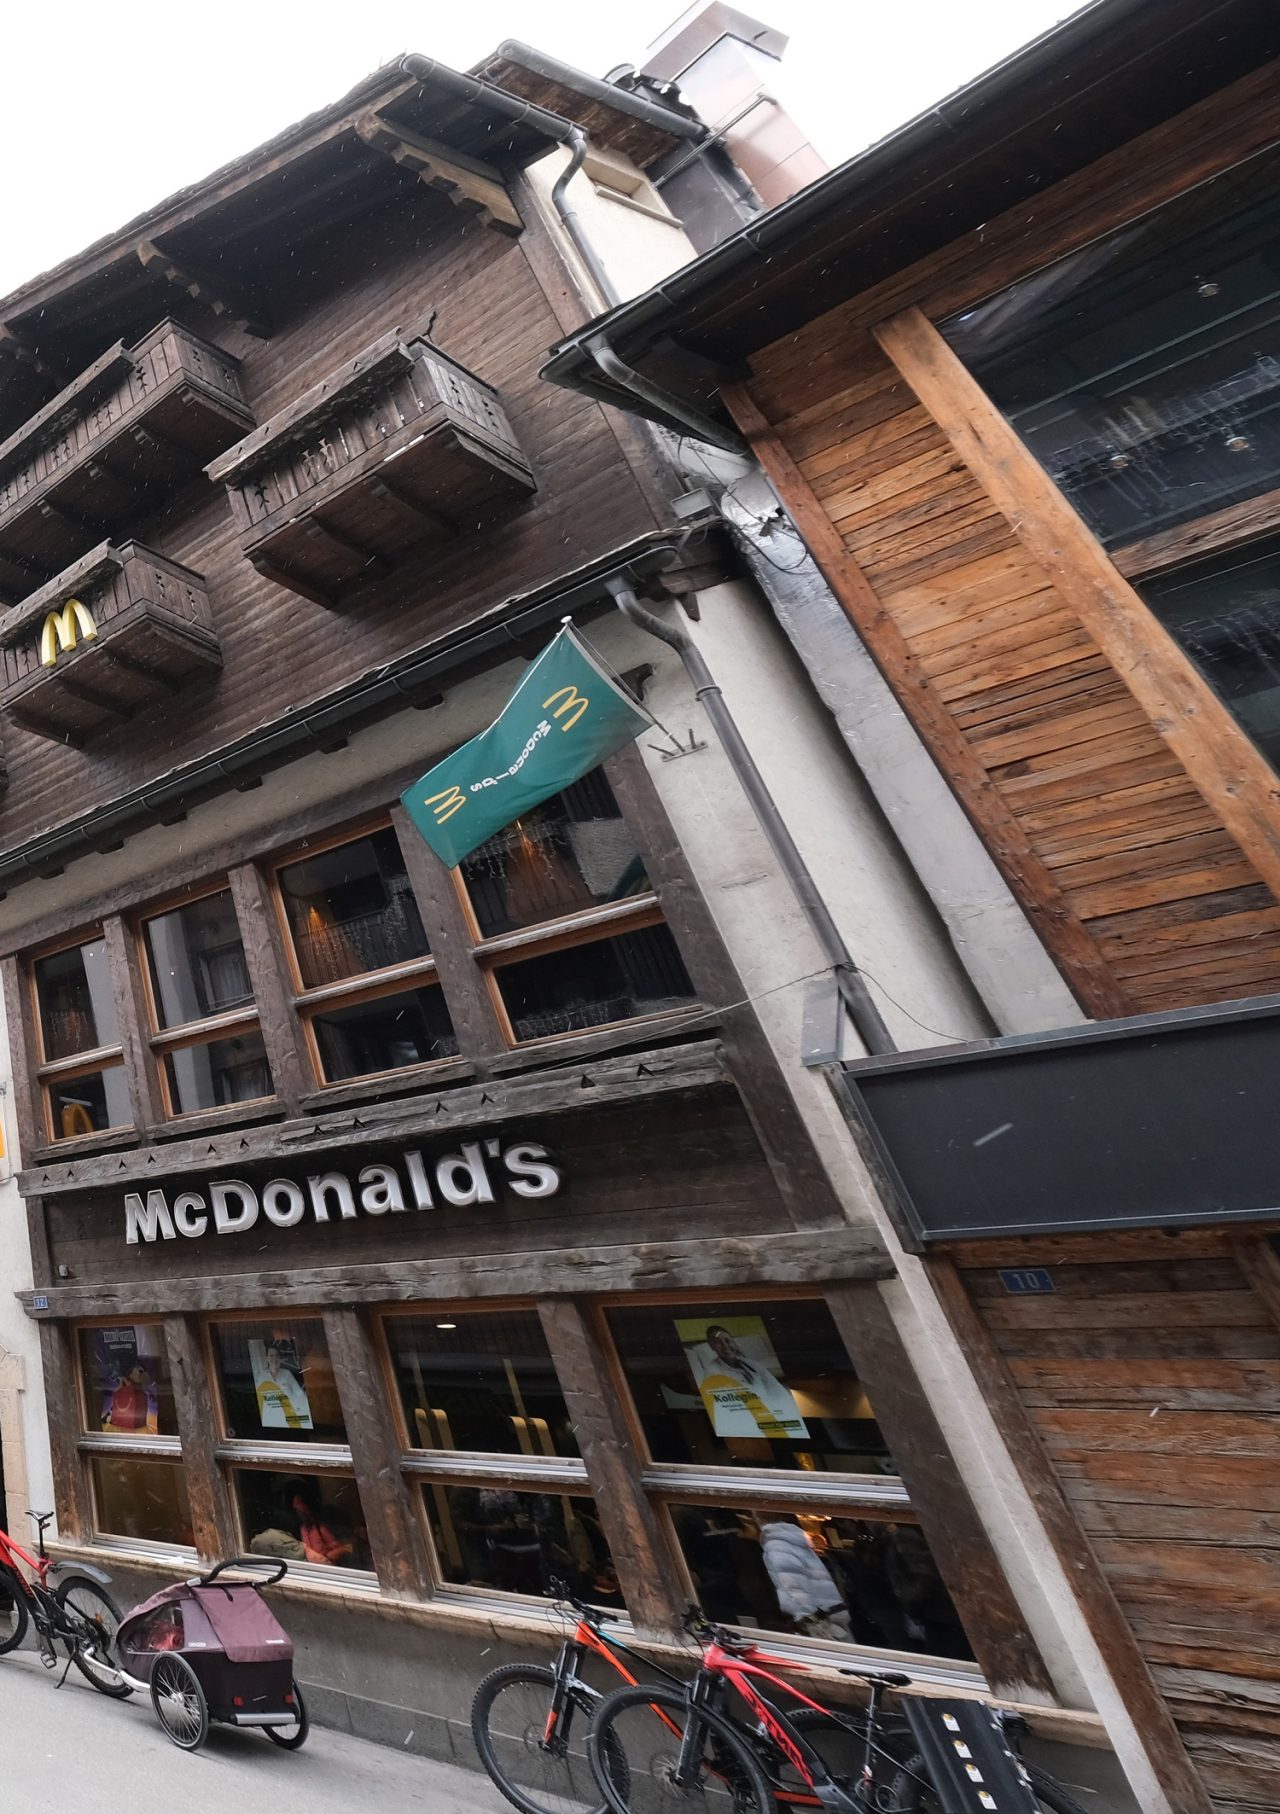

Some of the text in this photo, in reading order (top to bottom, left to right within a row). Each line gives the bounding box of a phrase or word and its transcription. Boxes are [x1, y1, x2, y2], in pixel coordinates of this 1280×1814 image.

[469, 718, 553, 794] McDonald's
[124, 1137, 561, 1245] McDonald's
[1012, 1272, 1041, 1290] 10
